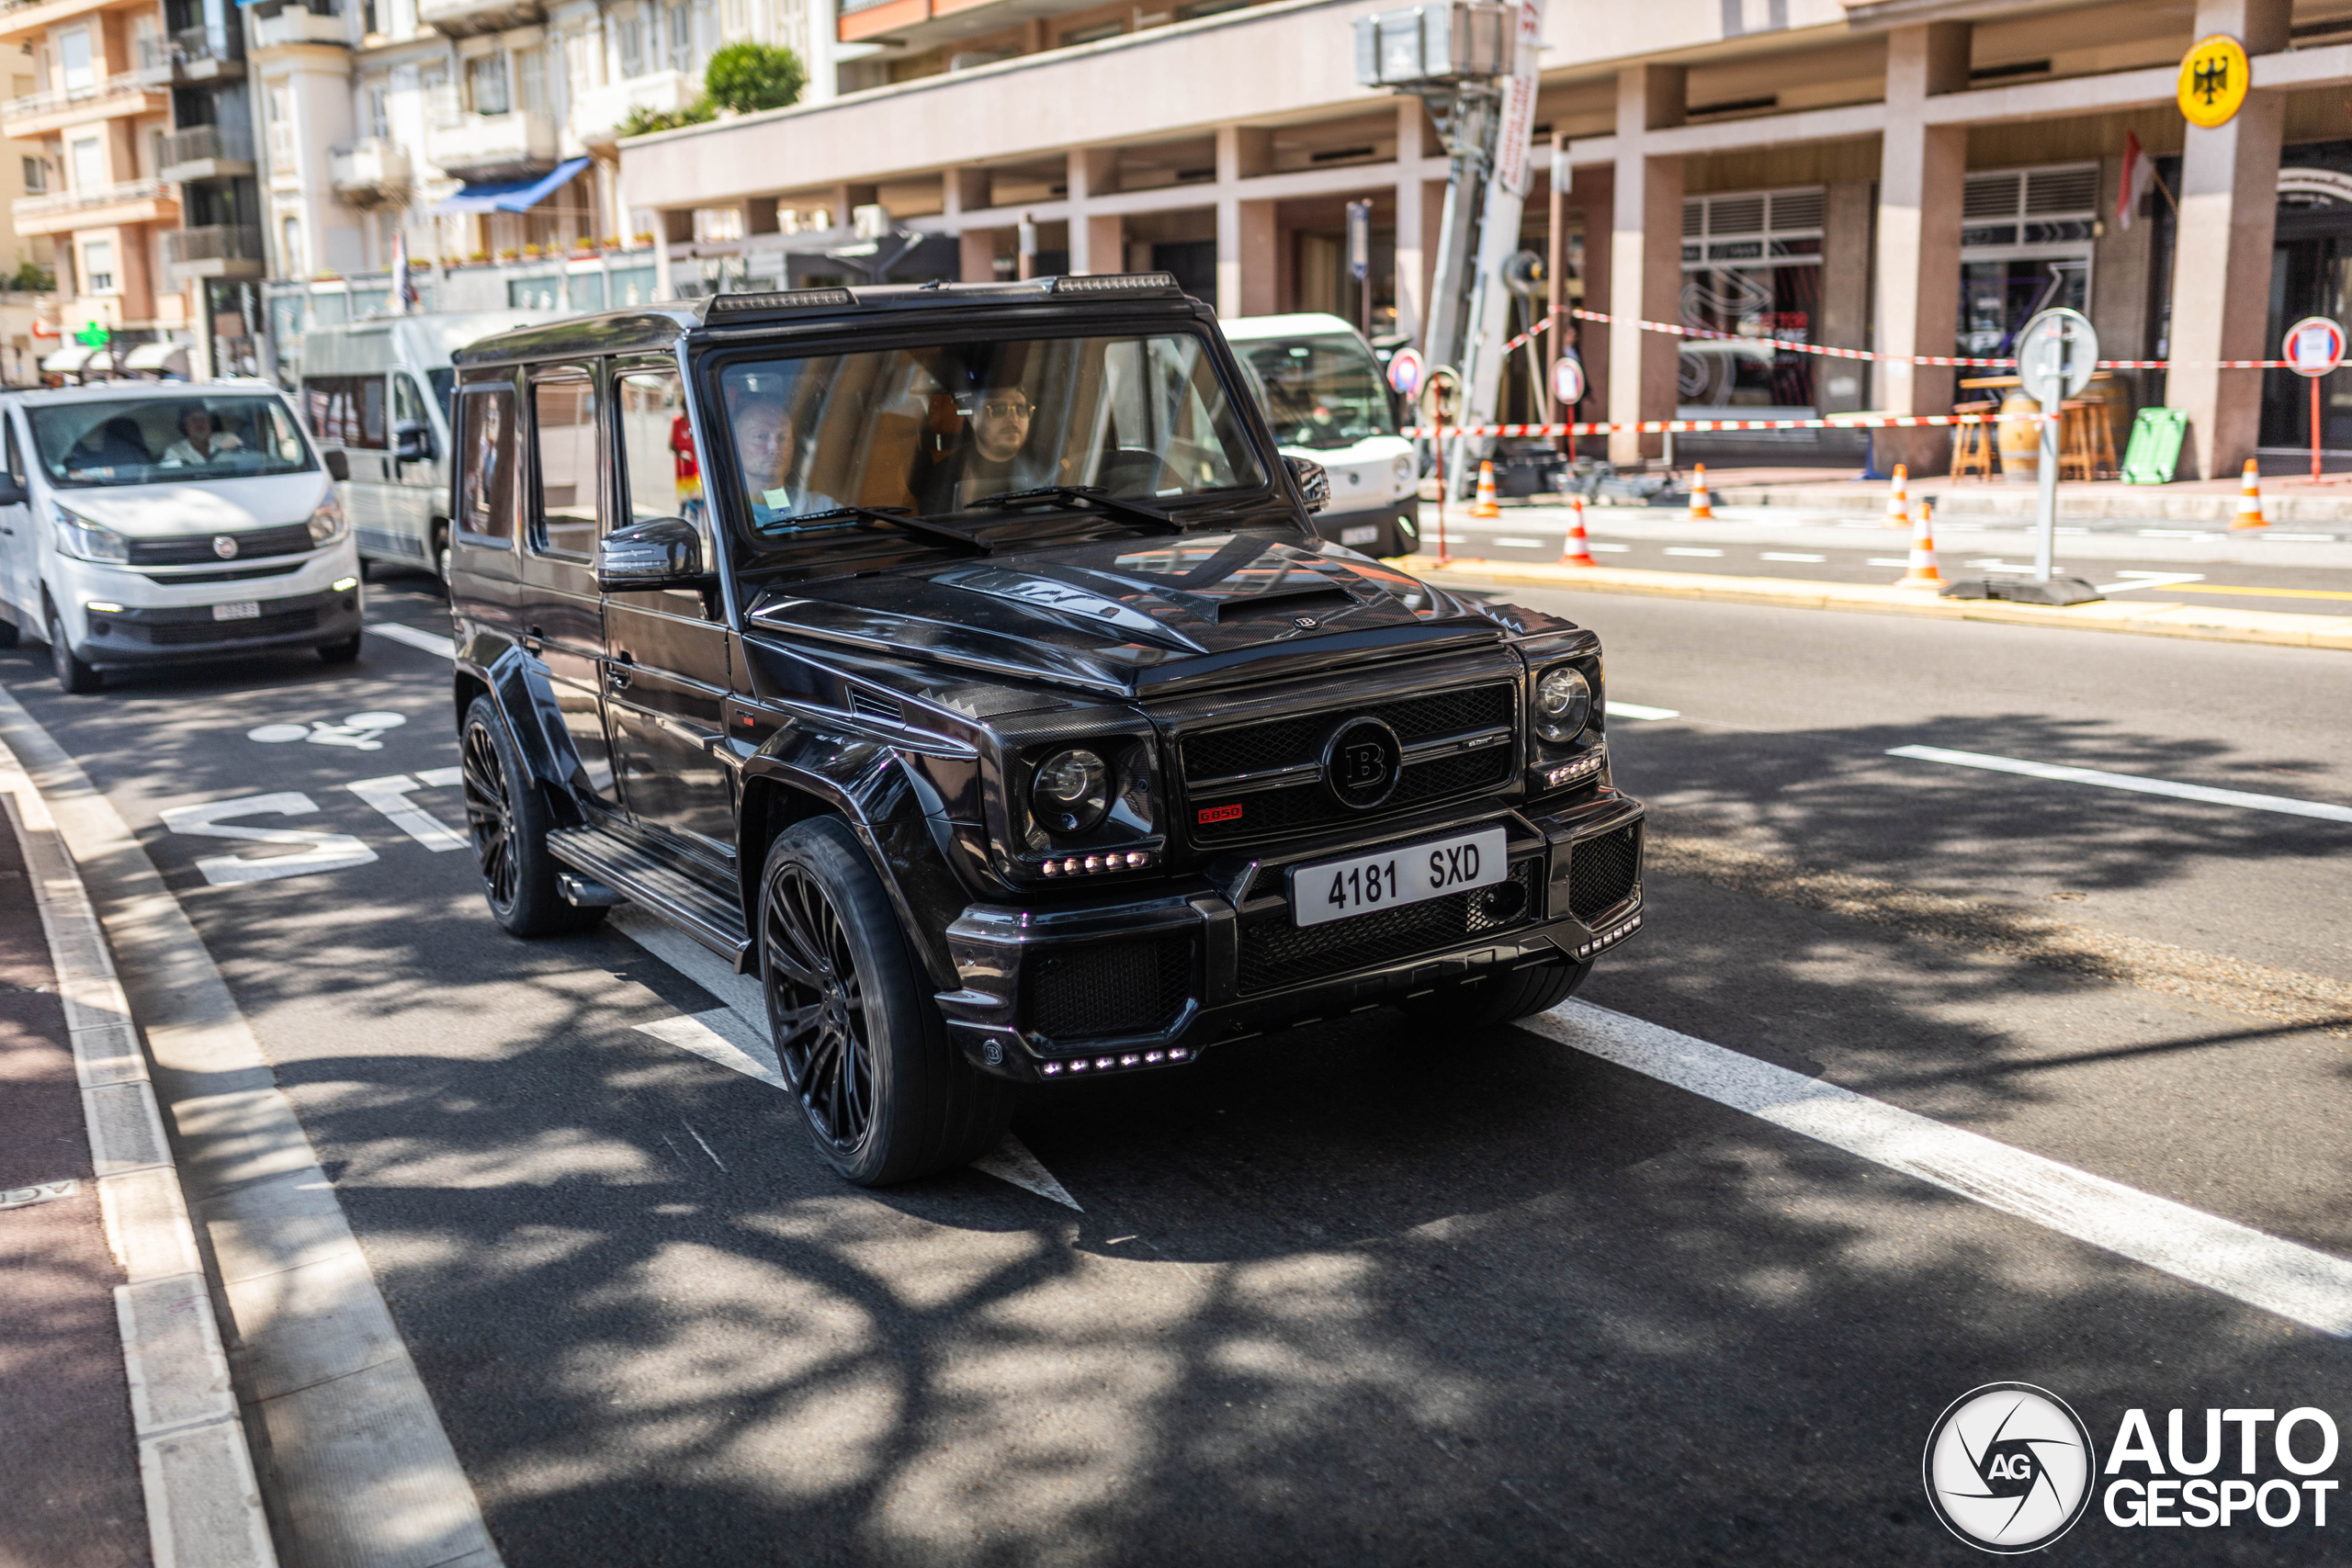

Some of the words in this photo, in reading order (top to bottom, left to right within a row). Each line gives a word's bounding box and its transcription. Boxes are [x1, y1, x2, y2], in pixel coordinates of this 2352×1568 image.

[1345, 742, 1387, 789] B
[1328, 859, 1396, 909] 4181
[1429, 843, 1480, 889] SXD
